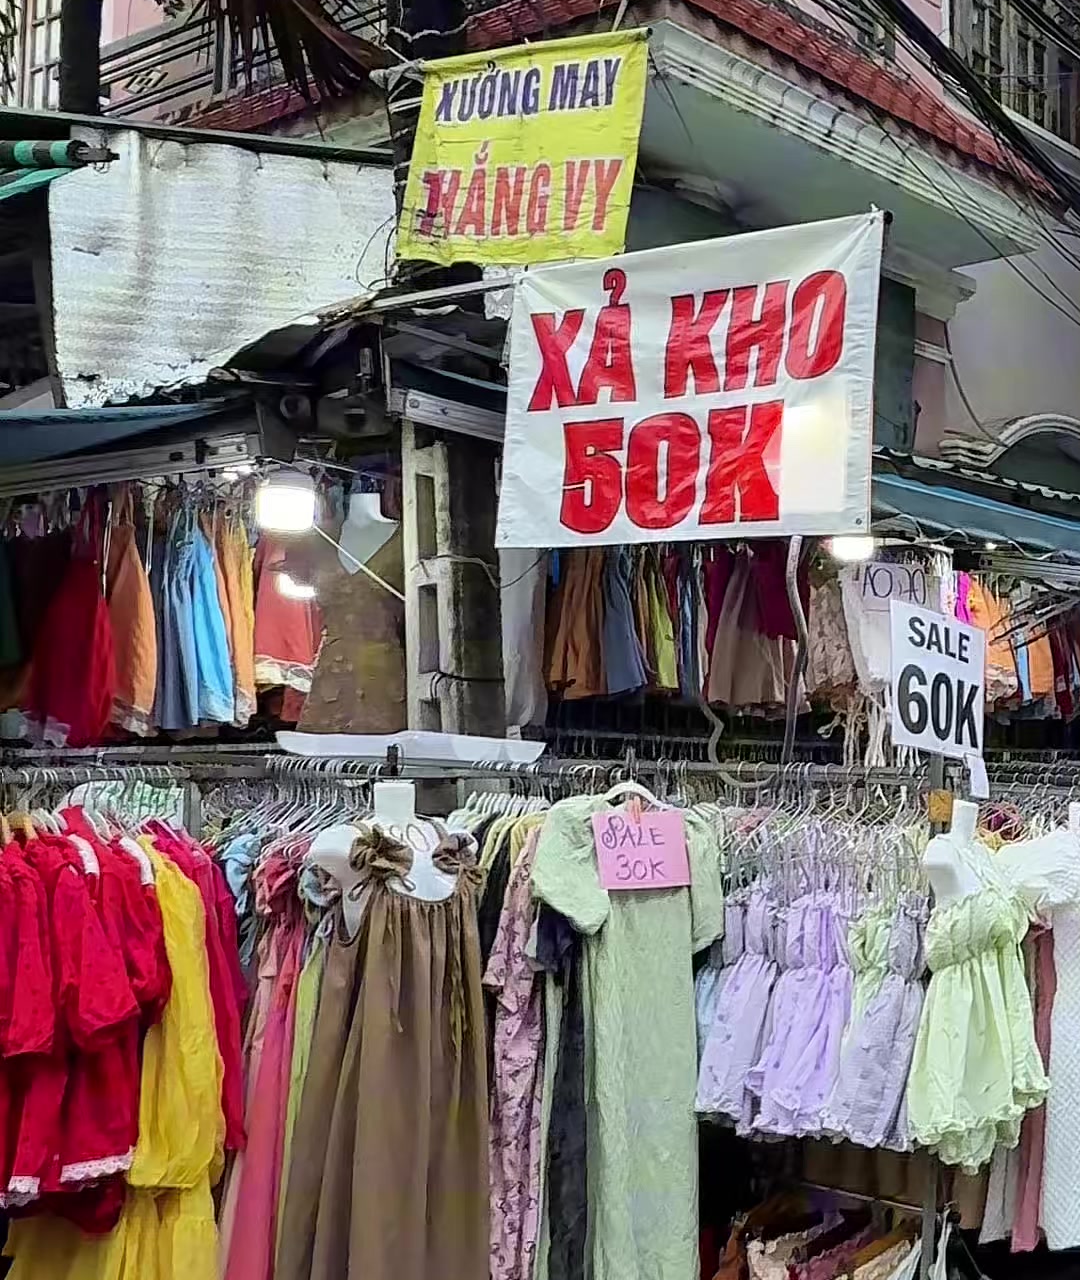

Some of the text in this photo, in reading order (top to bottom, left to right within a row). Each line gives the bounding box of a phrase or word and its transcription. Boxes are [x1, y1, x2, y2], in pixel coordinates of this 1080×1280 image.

[434, 57, 622, 122] XƯỞNG MAY
[563, 158, 623, 232] VY
[526, 267, 848, 412] XẢ KHO
[559, 399, 785, 535] 50K
[907, 616, 971, 664] SALE
[897, 663, 980, 749] 60K
[601, 815, 665, 850] SALE
[615, 853, 667, 882] 30K
